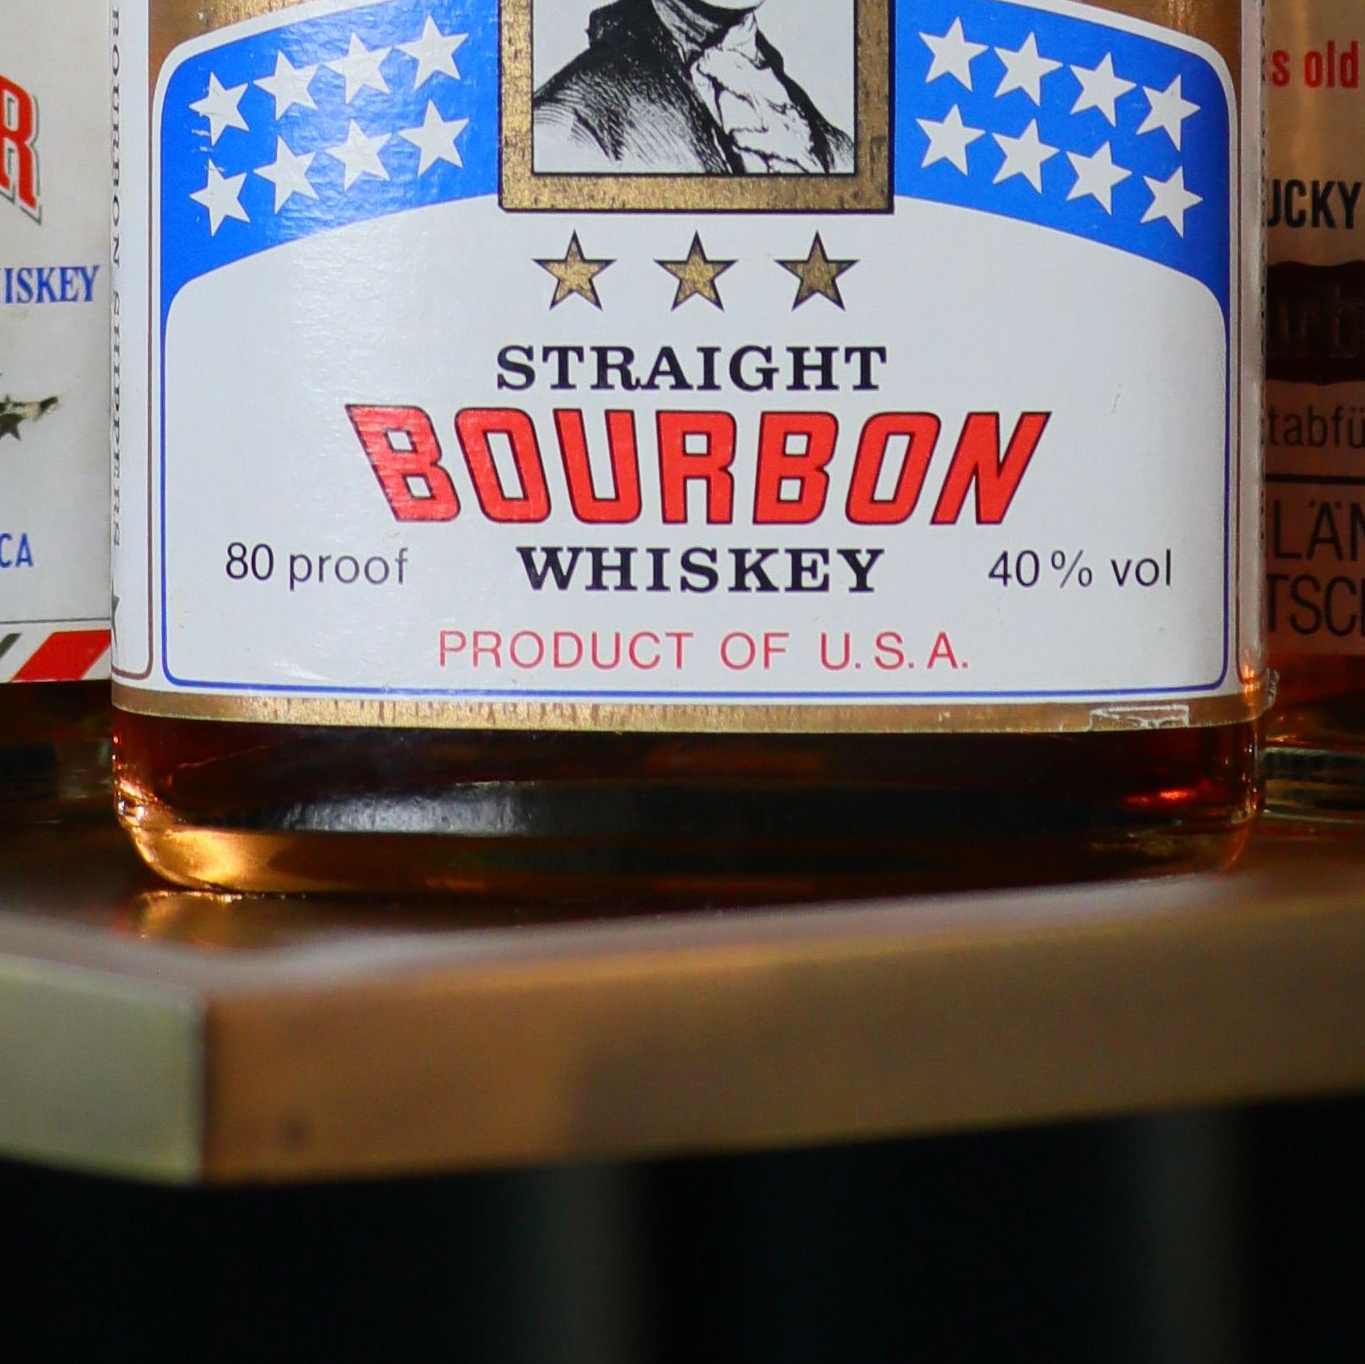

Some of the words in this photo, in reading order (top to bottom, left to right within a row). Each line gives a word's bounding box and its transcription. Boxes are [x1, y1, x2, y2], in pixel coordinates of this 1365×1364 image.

[1303, 40, 1359, 89] old
[496, 344, 888, 392] STRAIGHT
[344, 404, 1051, 526] BOURBON
[224, 543, 274, 581] 80
[288, 544, 410, 592] proof
[517, 545, 885, 594] WHISKEY
[1110, 547, 1173, 589] vol
[438, 632, 694, 671] PRODUCT
[720, 632, 789, 671] OF
[820, 631, 970, 671] U.S.A.
